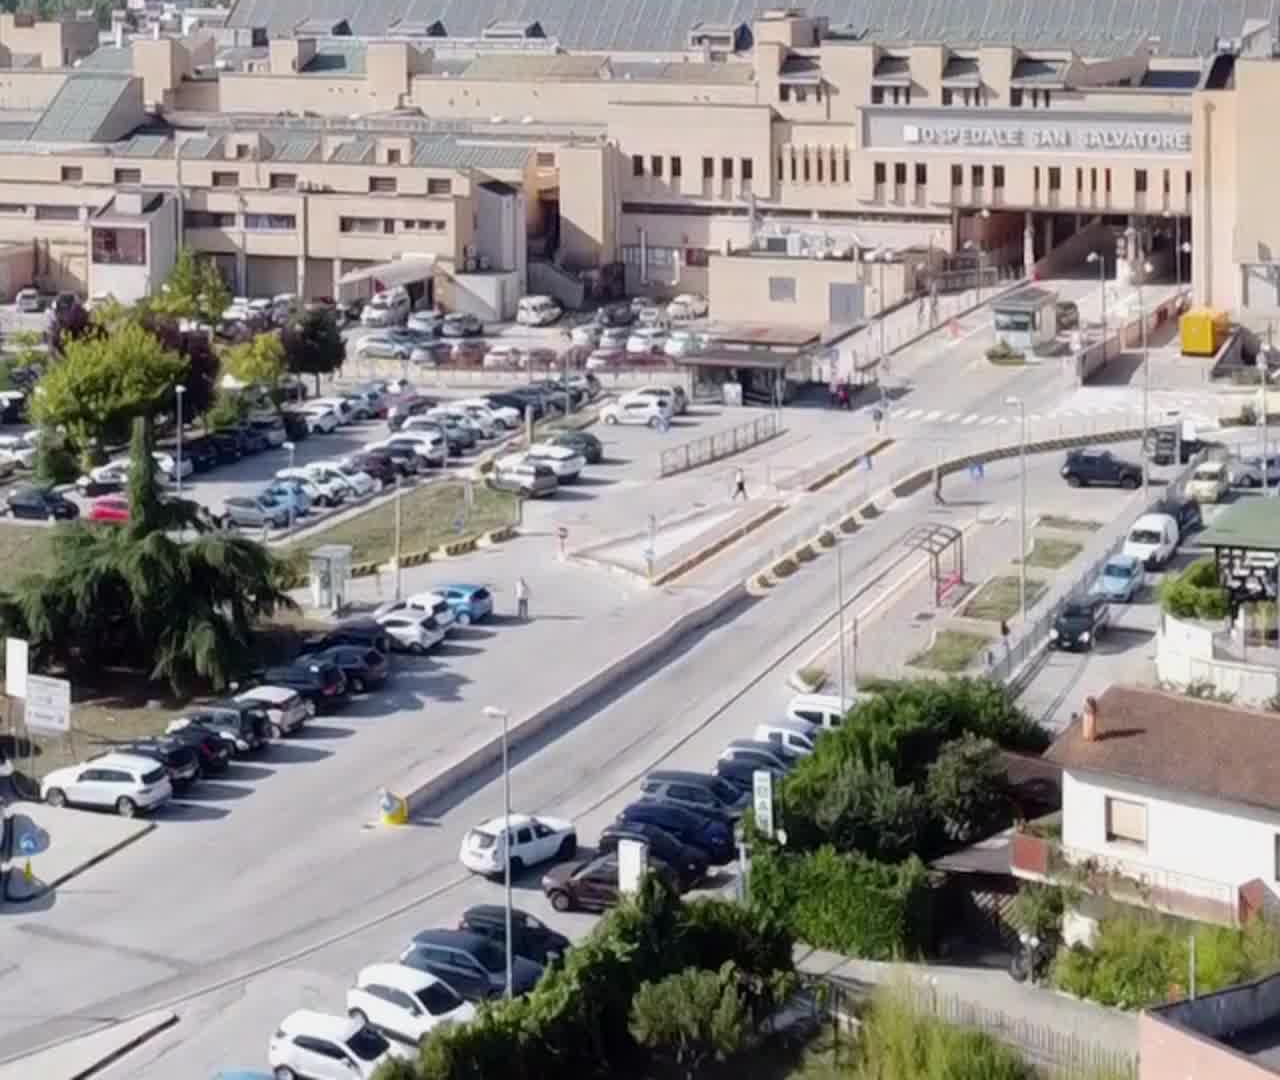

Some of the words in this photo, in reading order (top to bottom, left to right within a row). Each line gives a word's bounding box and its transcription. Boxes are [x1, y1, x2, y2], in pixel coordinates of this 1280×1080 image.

[920, 127, 1023, 144] OSPEDALE
[1031, 127, 1070, 146] SAN
[1079, 128, 1191, 150] SALVATORE
